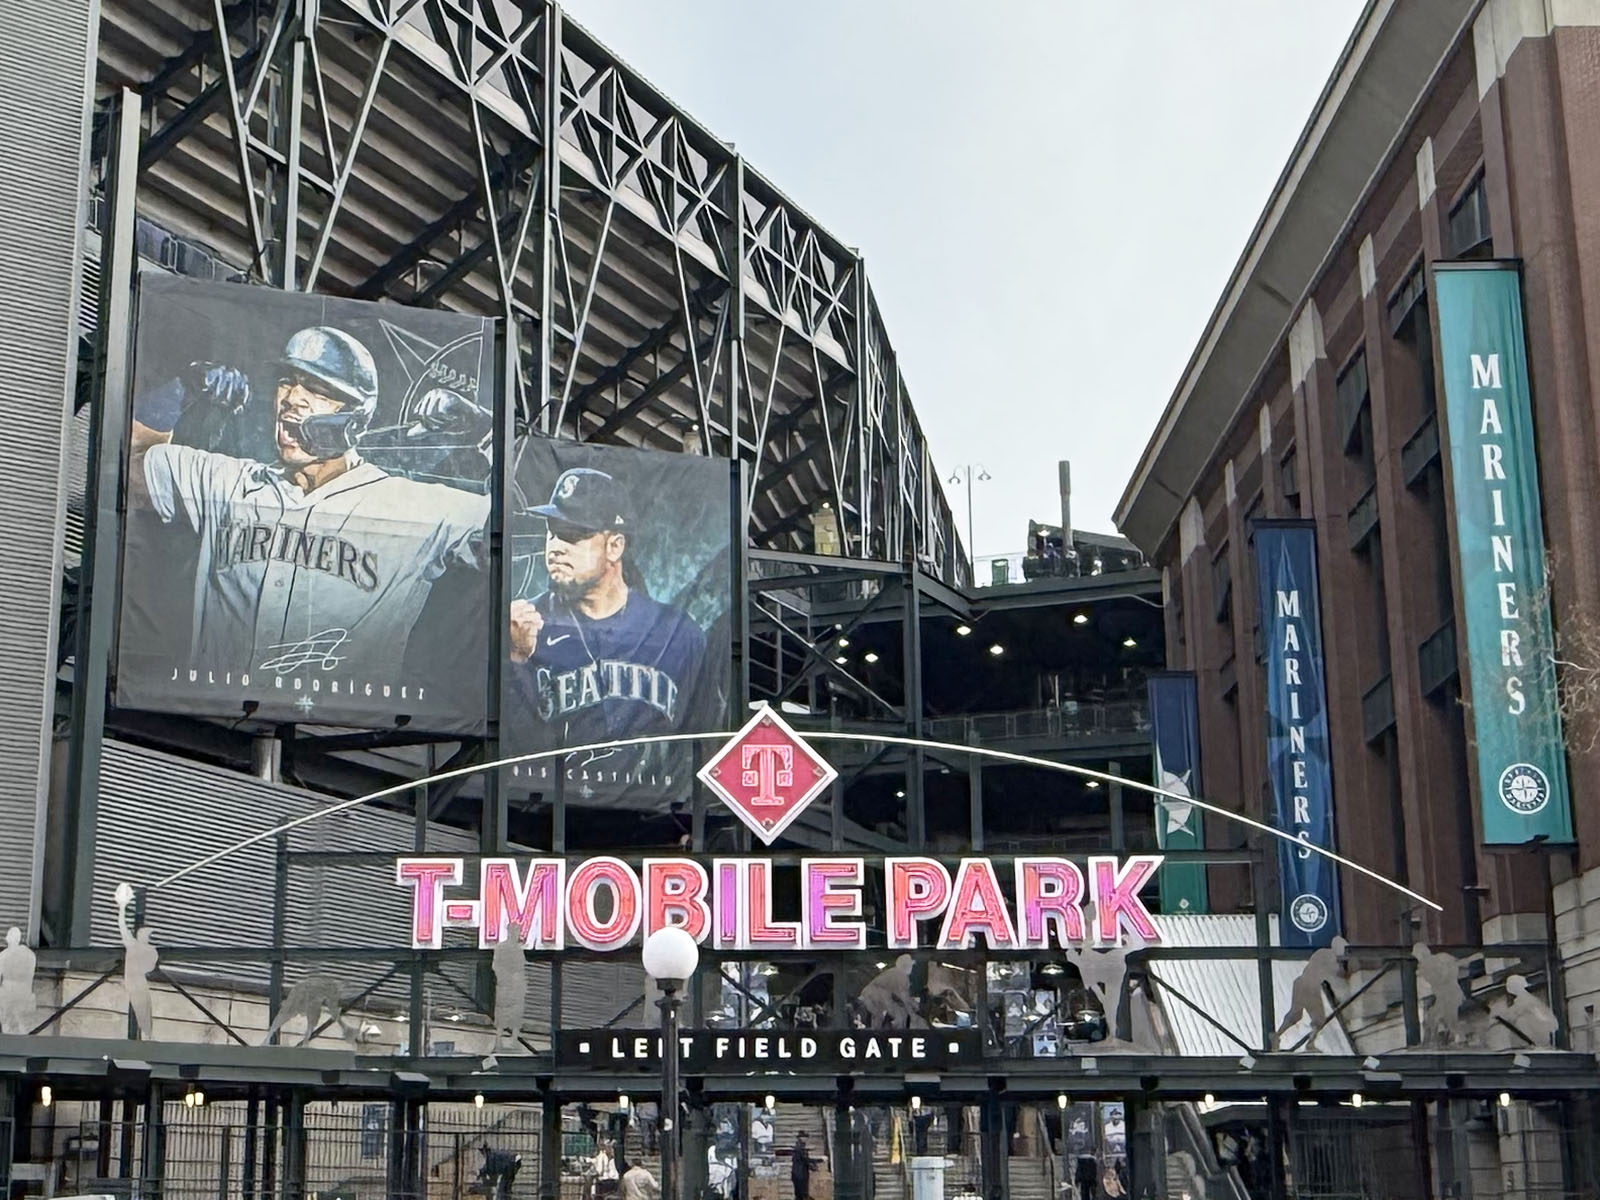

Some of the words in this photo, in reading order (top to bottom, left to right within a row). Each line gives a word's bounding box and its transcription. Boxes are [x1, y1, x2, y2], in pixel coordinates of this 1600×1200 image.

[1470, 353, 1526, 716] MARINERS
[171, 668, 249, 686] JULIO
[1276, 590, 1311, 859] MARINERS
[396, 857, 867, 951] T-MOBILE
[884, 857, 1164, 949] PARK
[716, 1037, 817, 1059] FIELD
[839, 1037, 927, 1059] GATE
